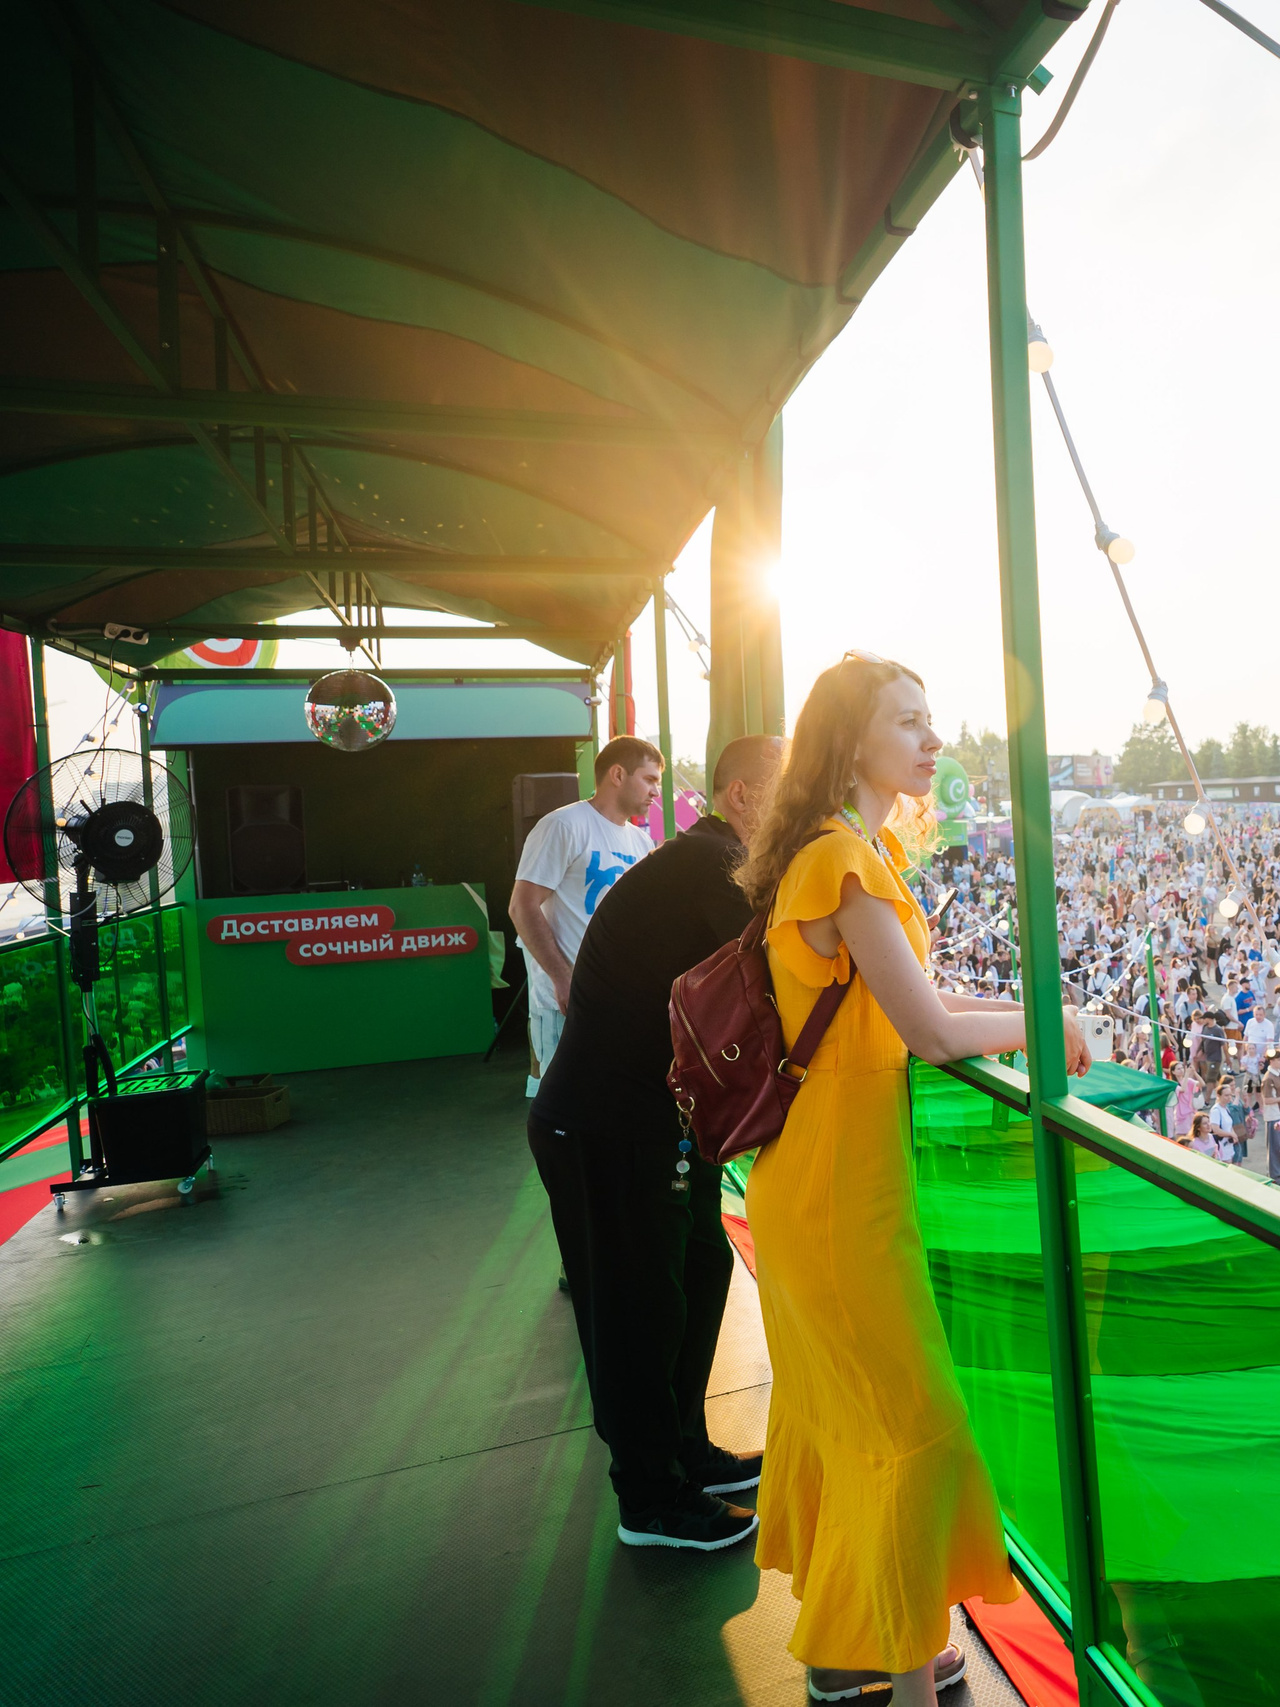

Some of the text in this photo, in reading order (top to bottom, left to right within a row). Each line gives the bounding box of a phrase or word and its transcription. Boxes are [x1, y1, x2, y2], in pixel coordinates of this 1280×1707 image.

[221, 912, 379, 939] Доставляем
[298, 931, 467, 957] сочный движ
